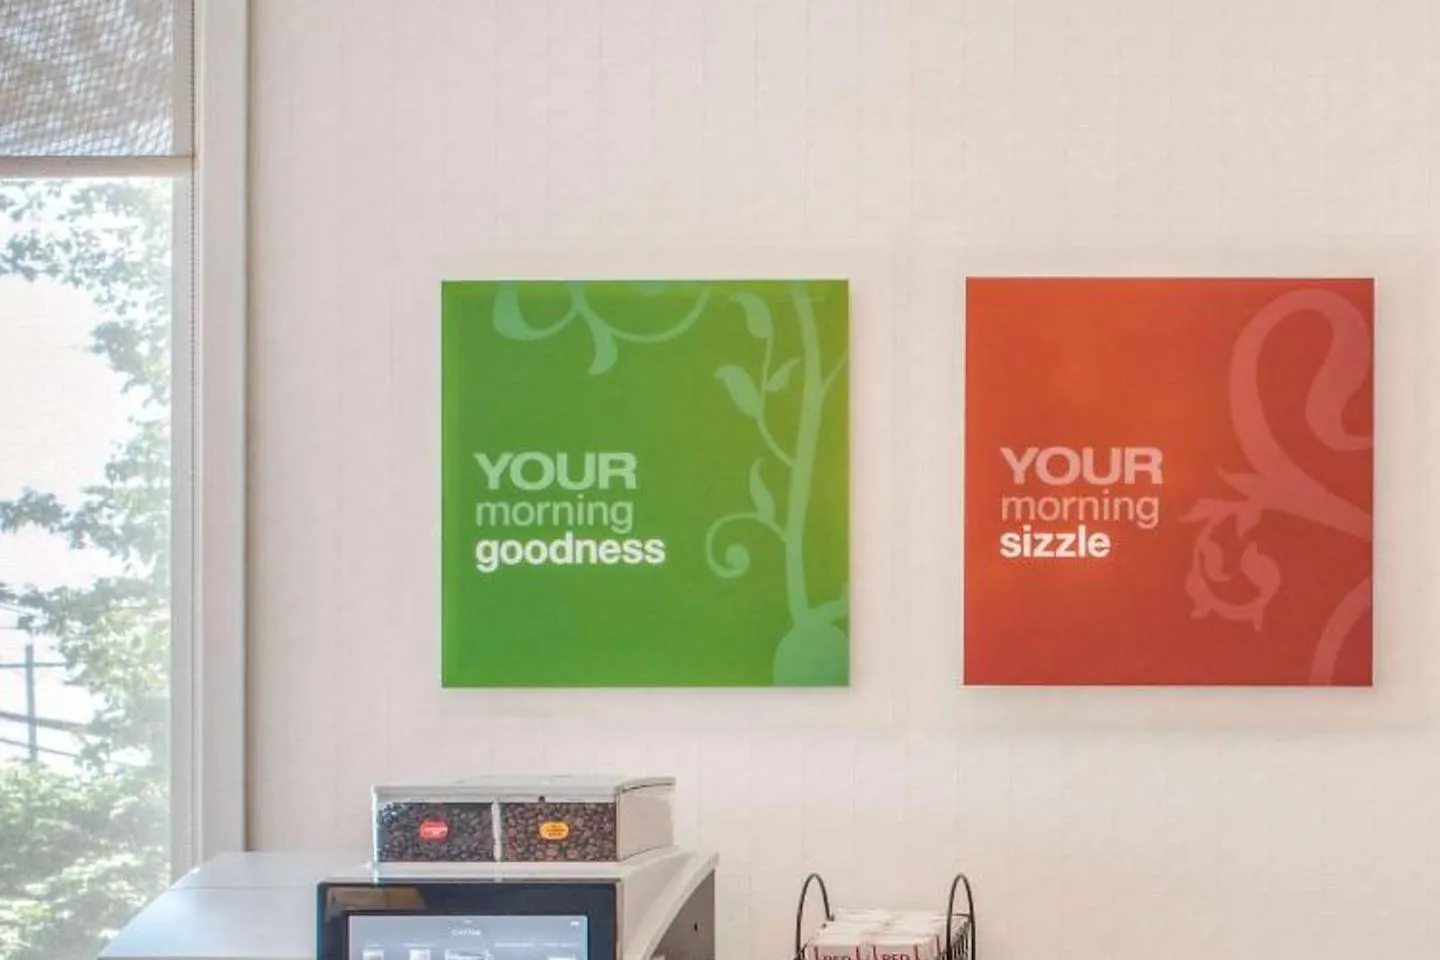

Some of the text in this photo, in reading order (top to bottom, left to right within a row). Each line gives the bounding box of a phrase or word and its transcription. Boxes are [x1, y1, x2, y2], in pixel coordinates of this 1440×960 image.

[474, 452, 637, 491] YOUR
[1000, 446, 1163, 486] YOUR
[475, 494, 634, 534] morning
[1001, 489, 1159, 530] morning
[475, 531, 666, 573] goodness
[1000, 524, 1111, 558] sizzle
